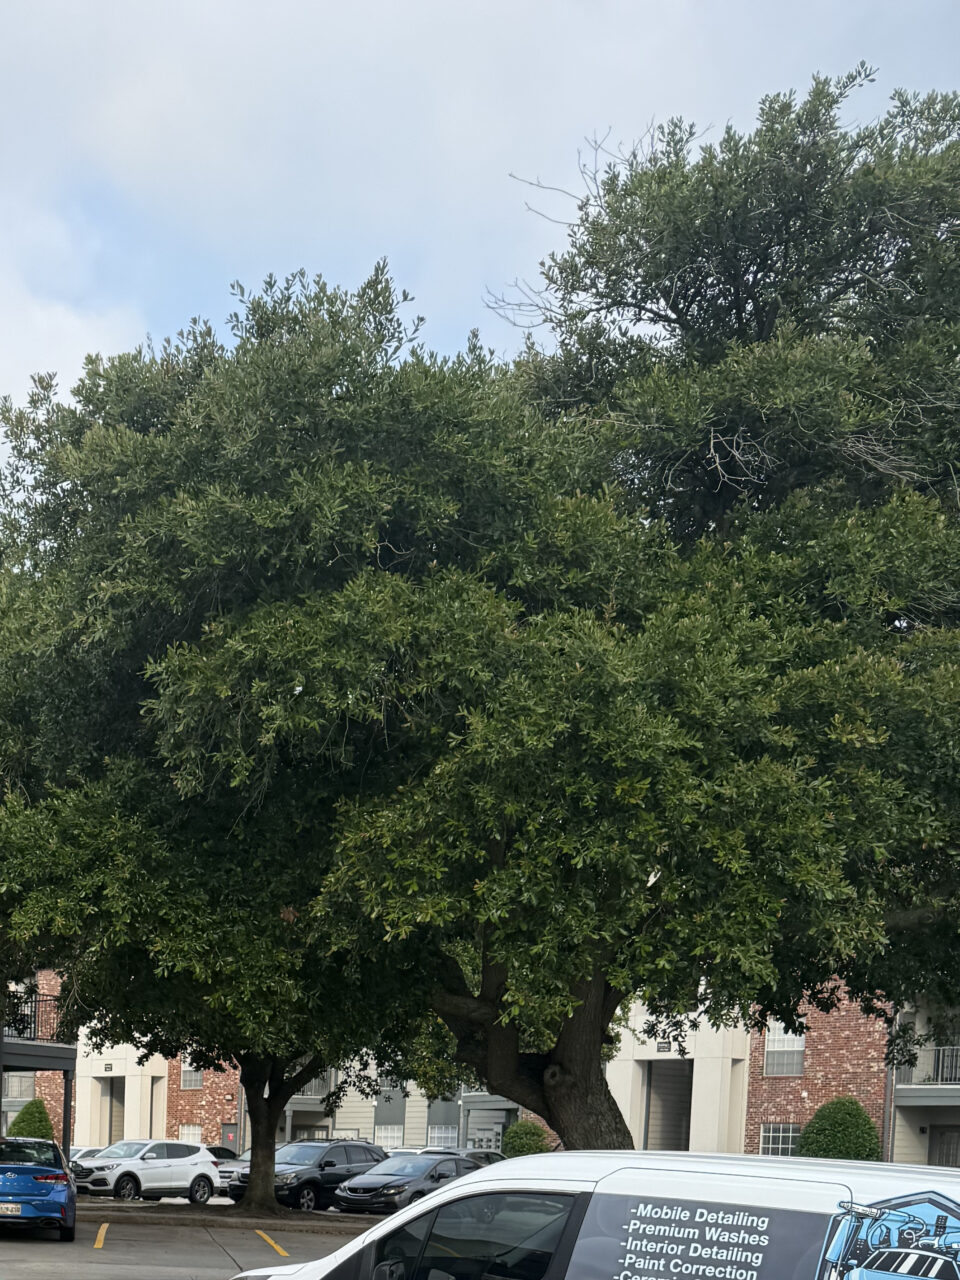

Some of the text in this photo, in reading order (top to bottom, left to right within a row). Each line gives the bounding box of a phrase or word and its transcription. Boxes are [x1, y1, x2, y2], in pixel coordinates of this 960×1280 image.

[630, 1203, 769, 1231] -Mobile Detailing
[622, 1220, 769, 1246] -Premium Washes
[618, 1254, 666, 1271] -Paint
[620, 1237, 763, 1267] -Interior Detailing
